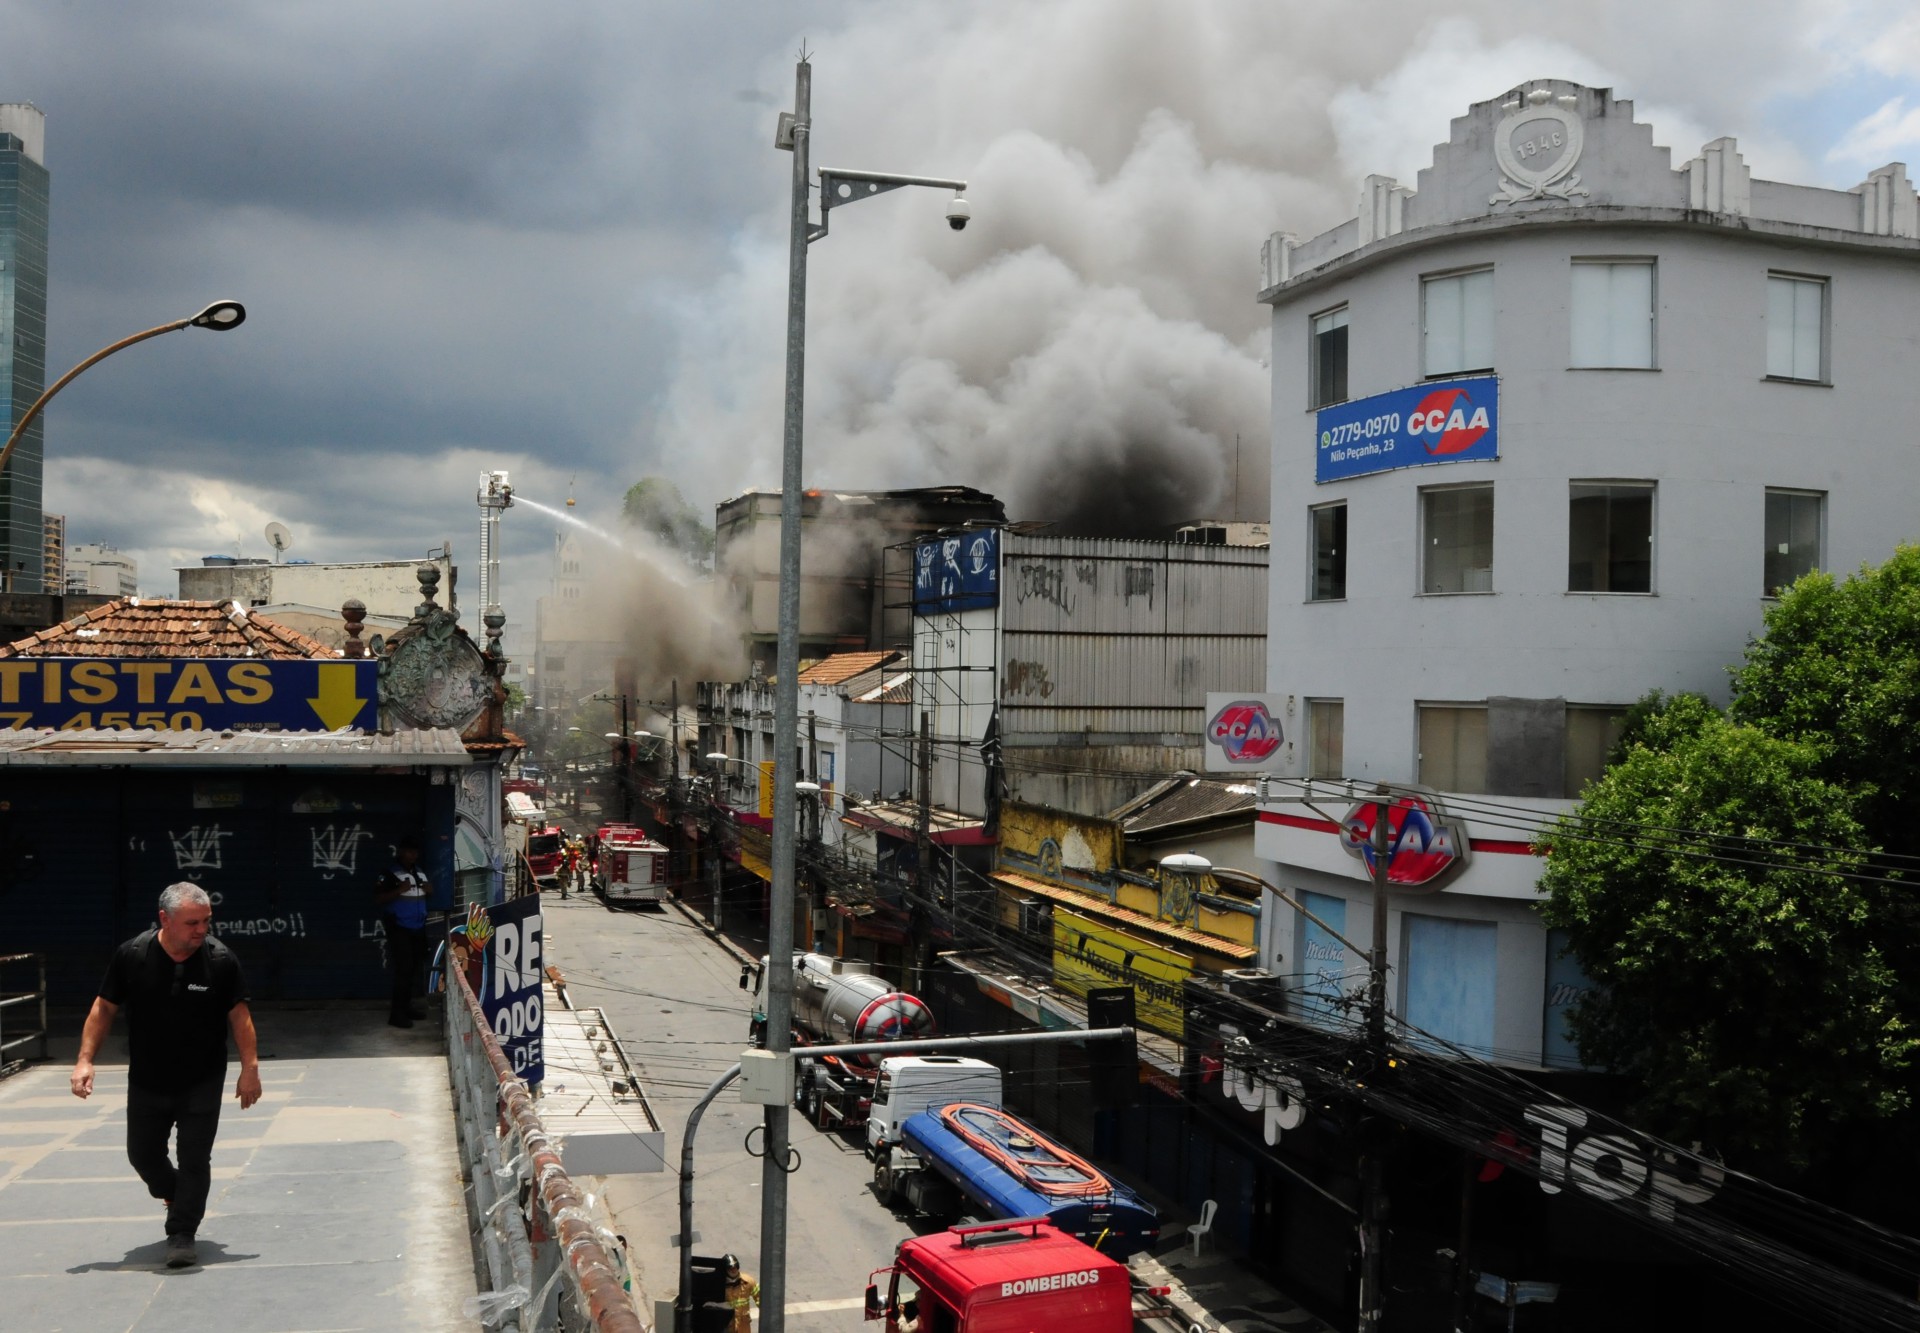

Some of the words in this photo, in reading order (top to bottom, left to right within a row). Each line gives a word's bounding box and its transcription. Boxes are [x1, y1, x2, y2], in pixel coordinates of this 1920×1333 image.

[1516, 132, 1562, 160] 1946
[1331, 412, 1400, 446] 2779-0970
[1407, 406, 1490, 436] CCAA
[1331, 449, 1345, 463] Nilo
[1346, 442, 1382, 460] Peçanha,
[1383, 438, 1395, 452] 23
[0, 662, 274, 705] TISTAS
[1210, 721, 1280, 740] CCAA
[1342, 818, 1455, 857] CCAA
[494, 914, 542, 1000] RE
[1001, 1268, 1099, 1297] BOMBEIROS
